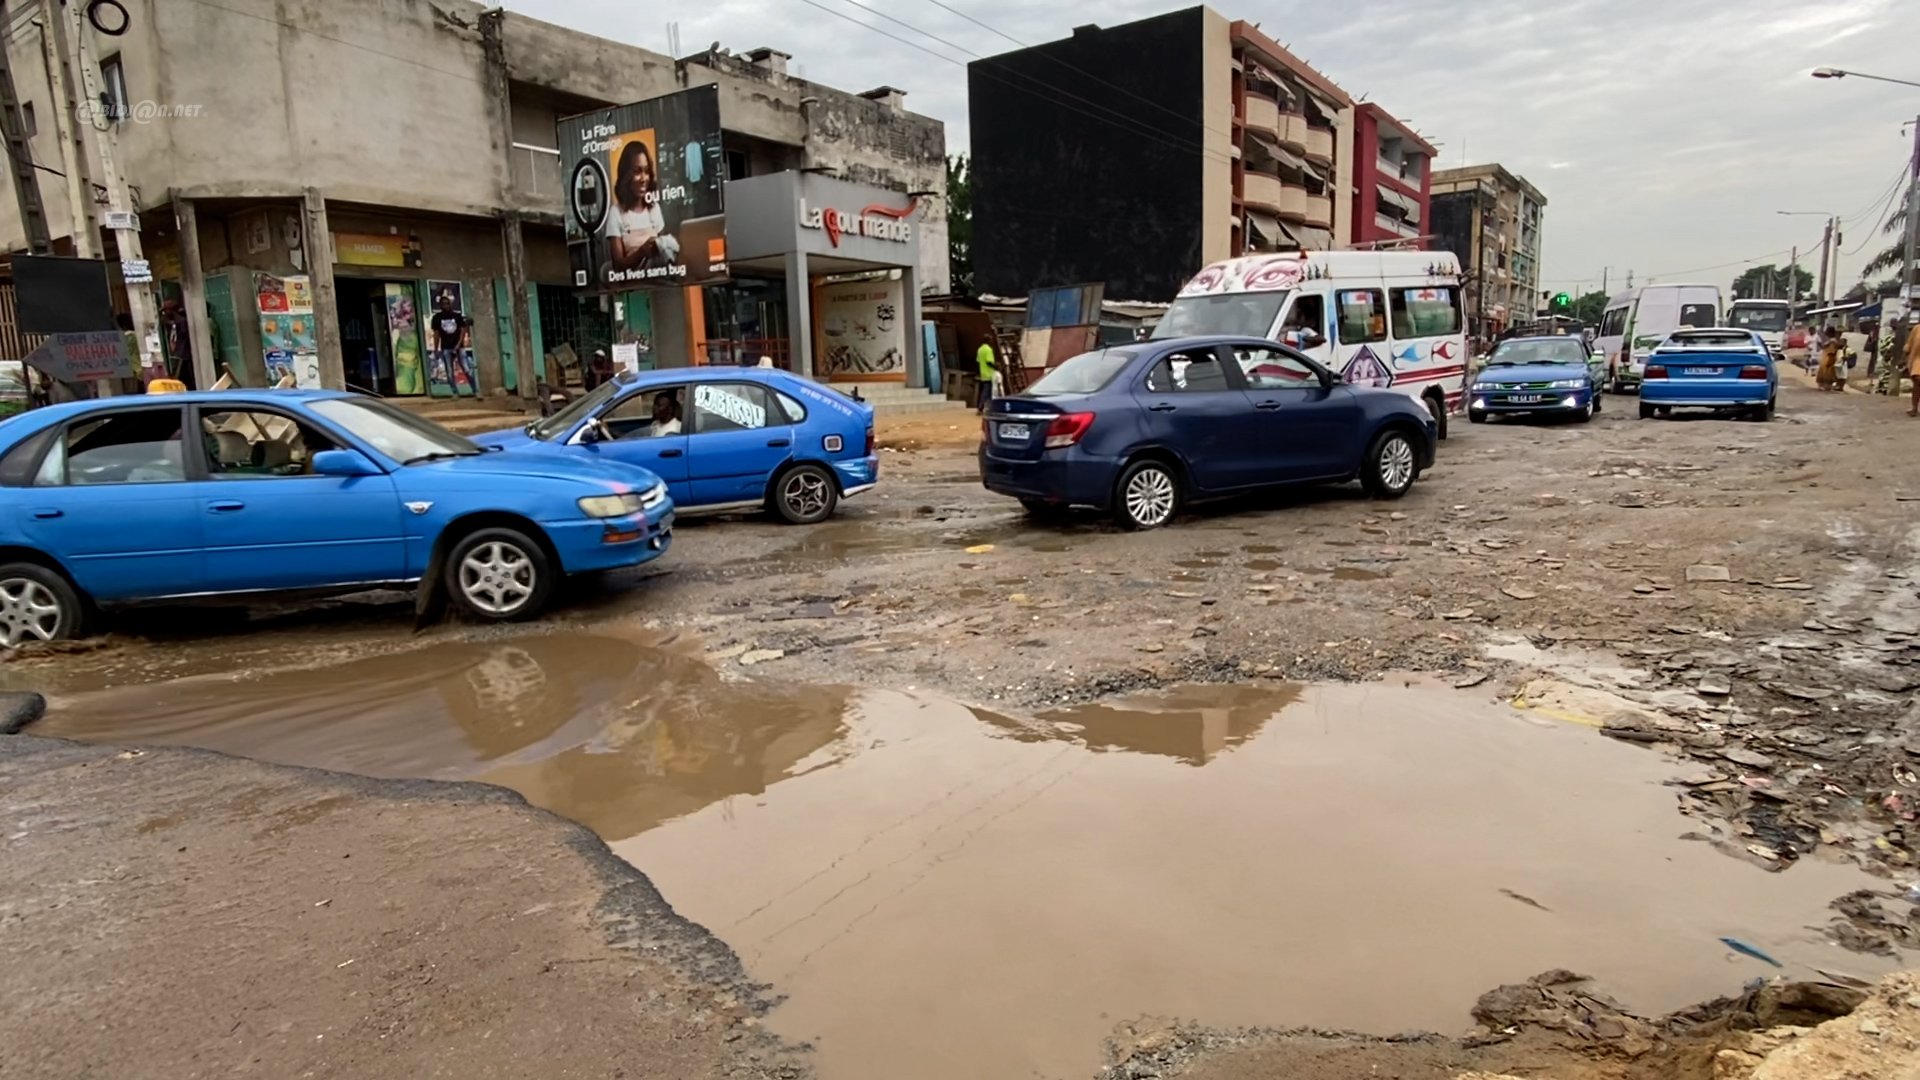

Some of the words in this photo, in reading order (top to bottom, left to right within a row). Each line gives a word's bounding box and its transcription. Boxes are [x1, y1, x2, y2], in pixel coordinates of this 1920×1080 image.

[581, 128, 593, 141] La
[593, 124, 617, 138] Fibre
[582, 138, 623, 155] d'Orange
[645, 190, 660, 204] ou
[662, 184, 685, 201] rien
[800, 198, 823, 230] La
[608, 270, 625, 282] Des
[626, 268, 645, 280] lives
[646, 267, 668, 278] sans
[669, 264, 686, 276] bug
